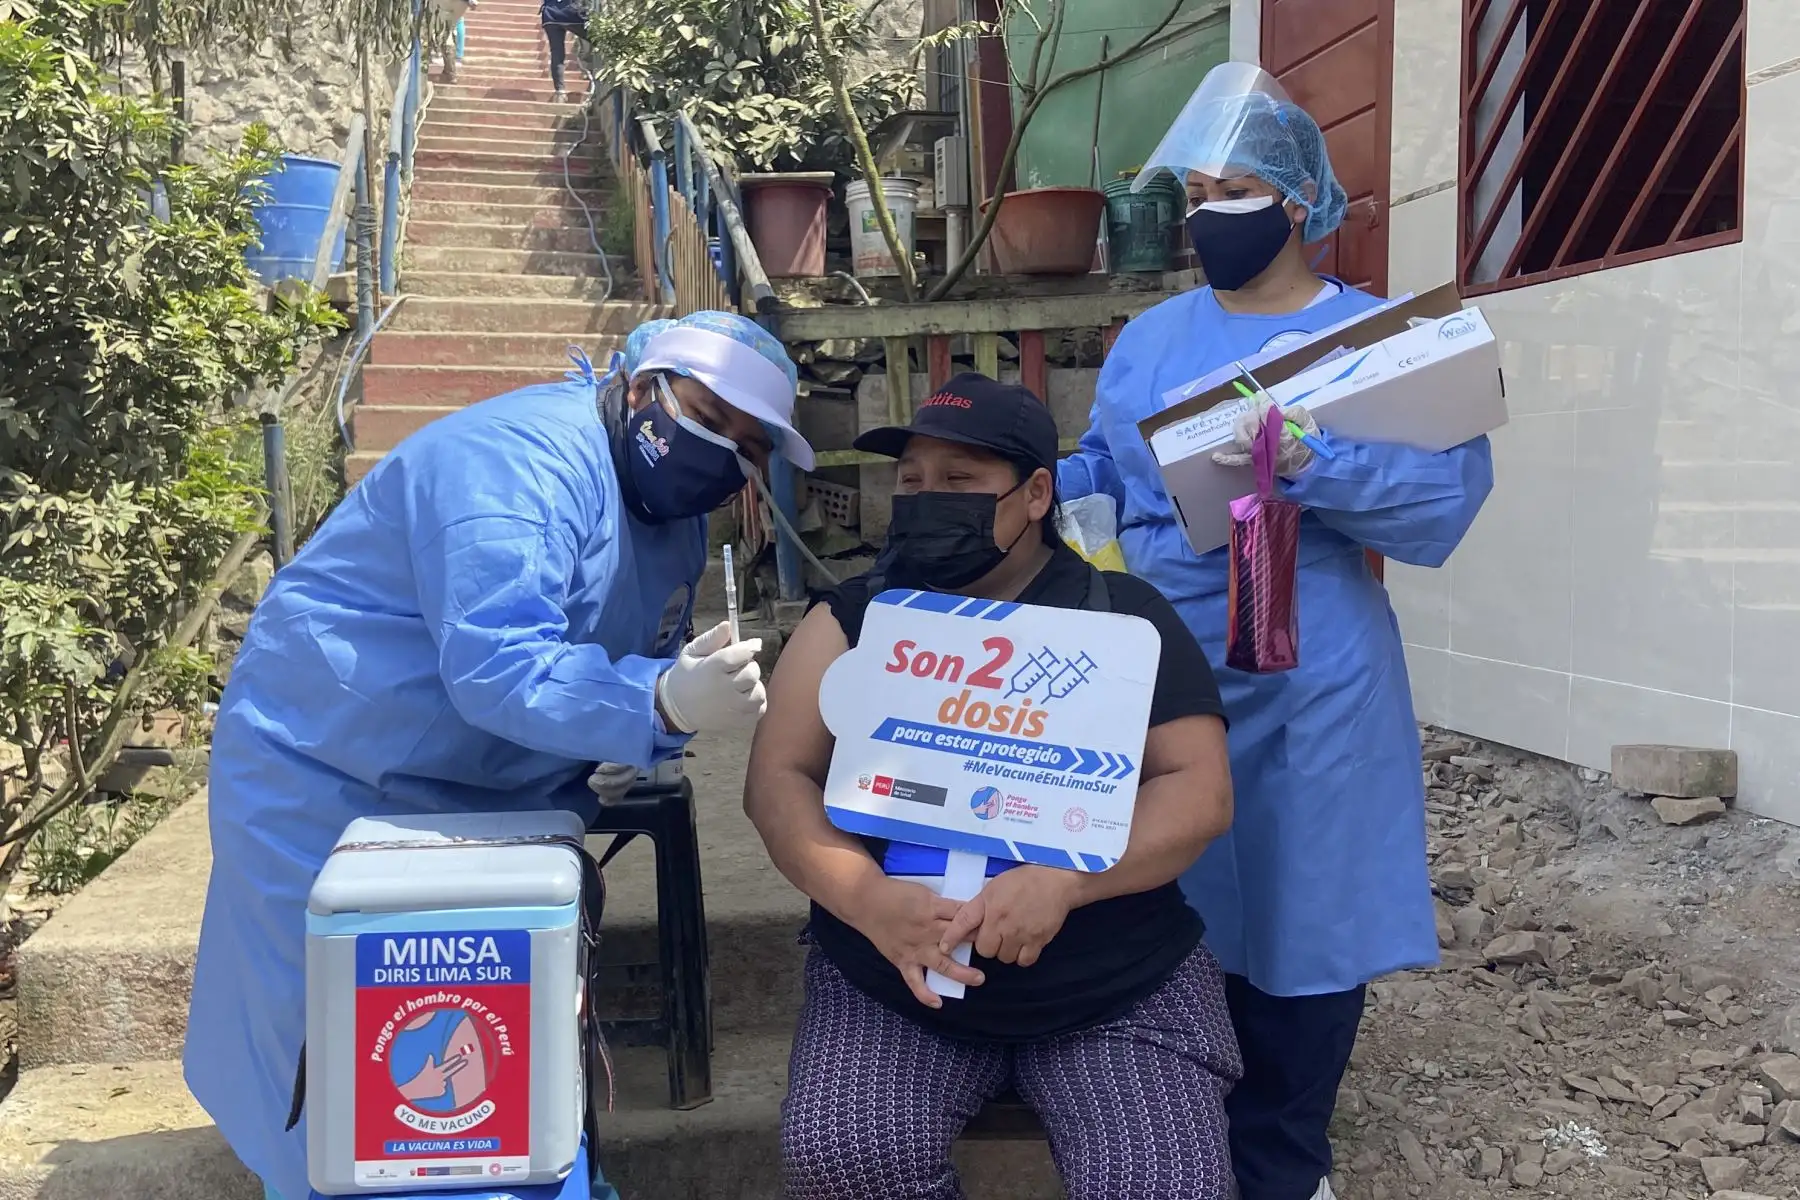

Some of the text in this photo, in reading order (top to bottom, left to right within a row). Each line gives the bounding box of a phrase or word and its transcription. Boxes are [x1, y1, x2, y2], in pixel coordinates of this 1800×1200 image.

[1442, 321, 1478, 338] Wealy
[1175, 403, 1248, 437] SAFETY SYR
[885, 636, 1014, 690] Son 2
[937, 689, 1048, 738] dosis
[892, 724, 1062, 764] para estar protegido
[963, 759, 1117, 795] #MeVacunéEnLimaSur
[383, 936, 502, 965] MINSA
[374, 966, 512, 983] DIRIS LIMA SUR
[371, 990, 515, 1062] Pongo el hombro por el Perú
[400, 1104, 490, 1131] YO ME VACUNO
[392, 1139, 492, 1152] LA VACUNA ES VIDA
